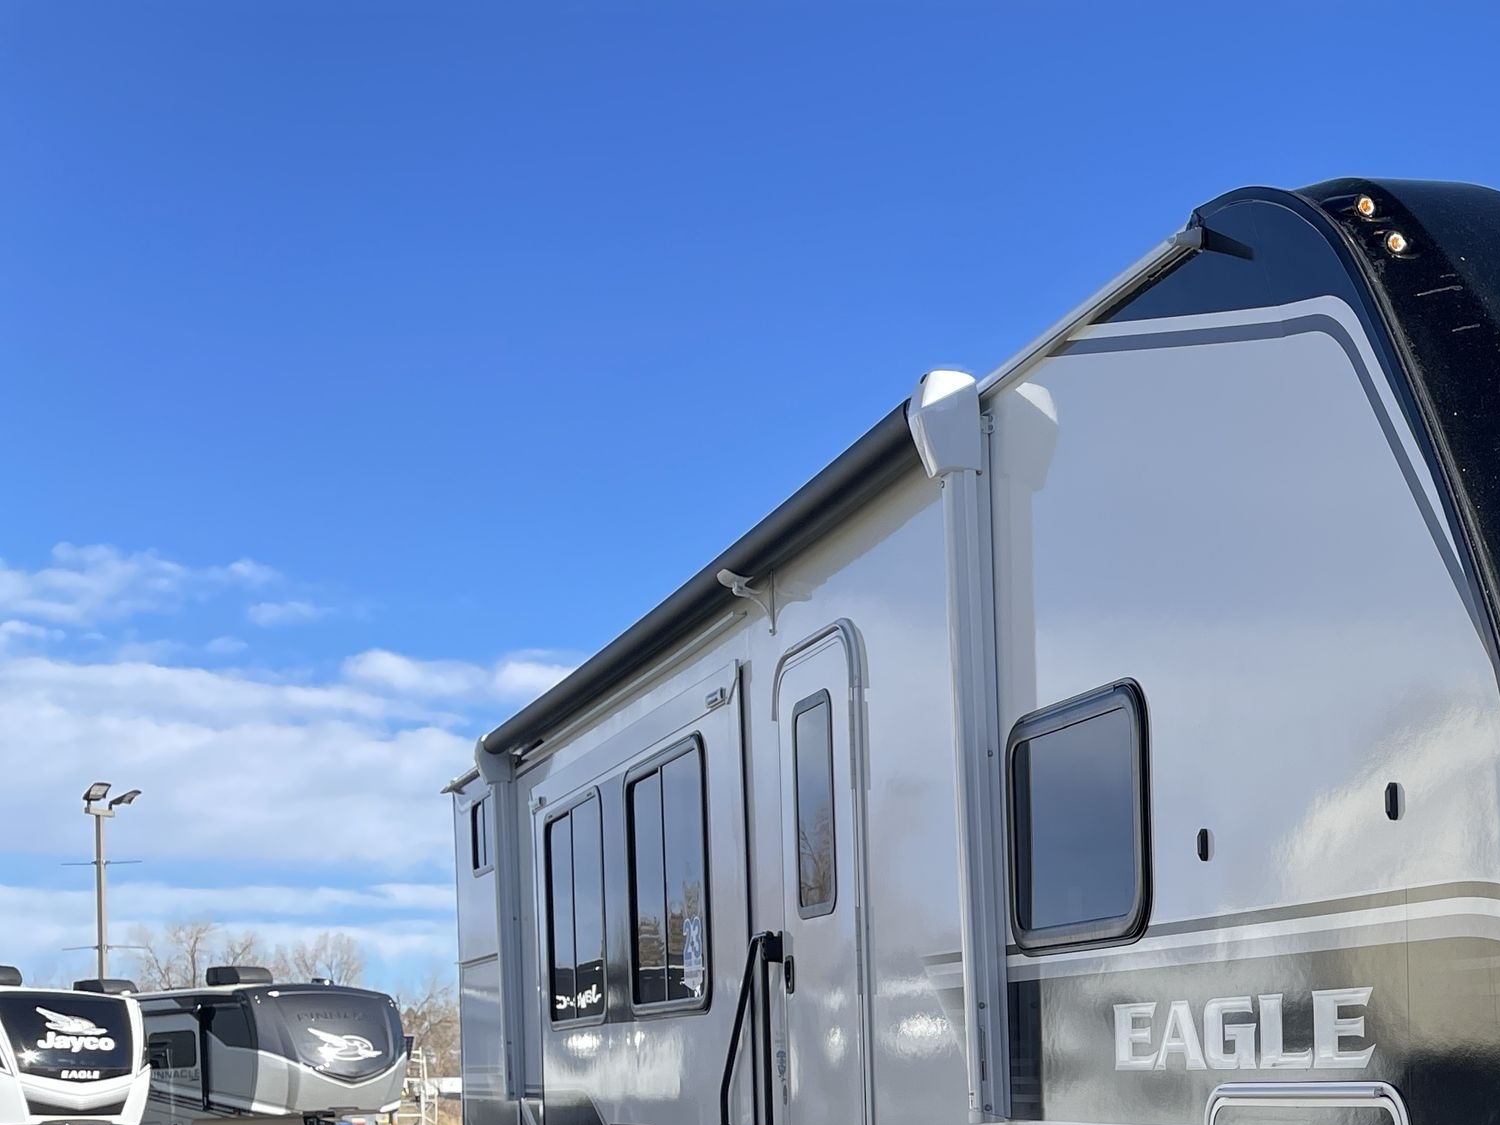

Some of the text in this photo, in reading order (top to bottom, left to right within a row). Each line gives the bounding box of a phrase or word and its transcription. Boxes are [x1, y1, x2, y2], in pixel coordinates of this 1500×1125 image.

[1113, 987, 1377, 1071] EAGLE
[37, 1031, 115, 1053] Jayco
[61, 1069, 100, 1080] EAGLE
[151, 1068, 201, 1079] INNACLE
